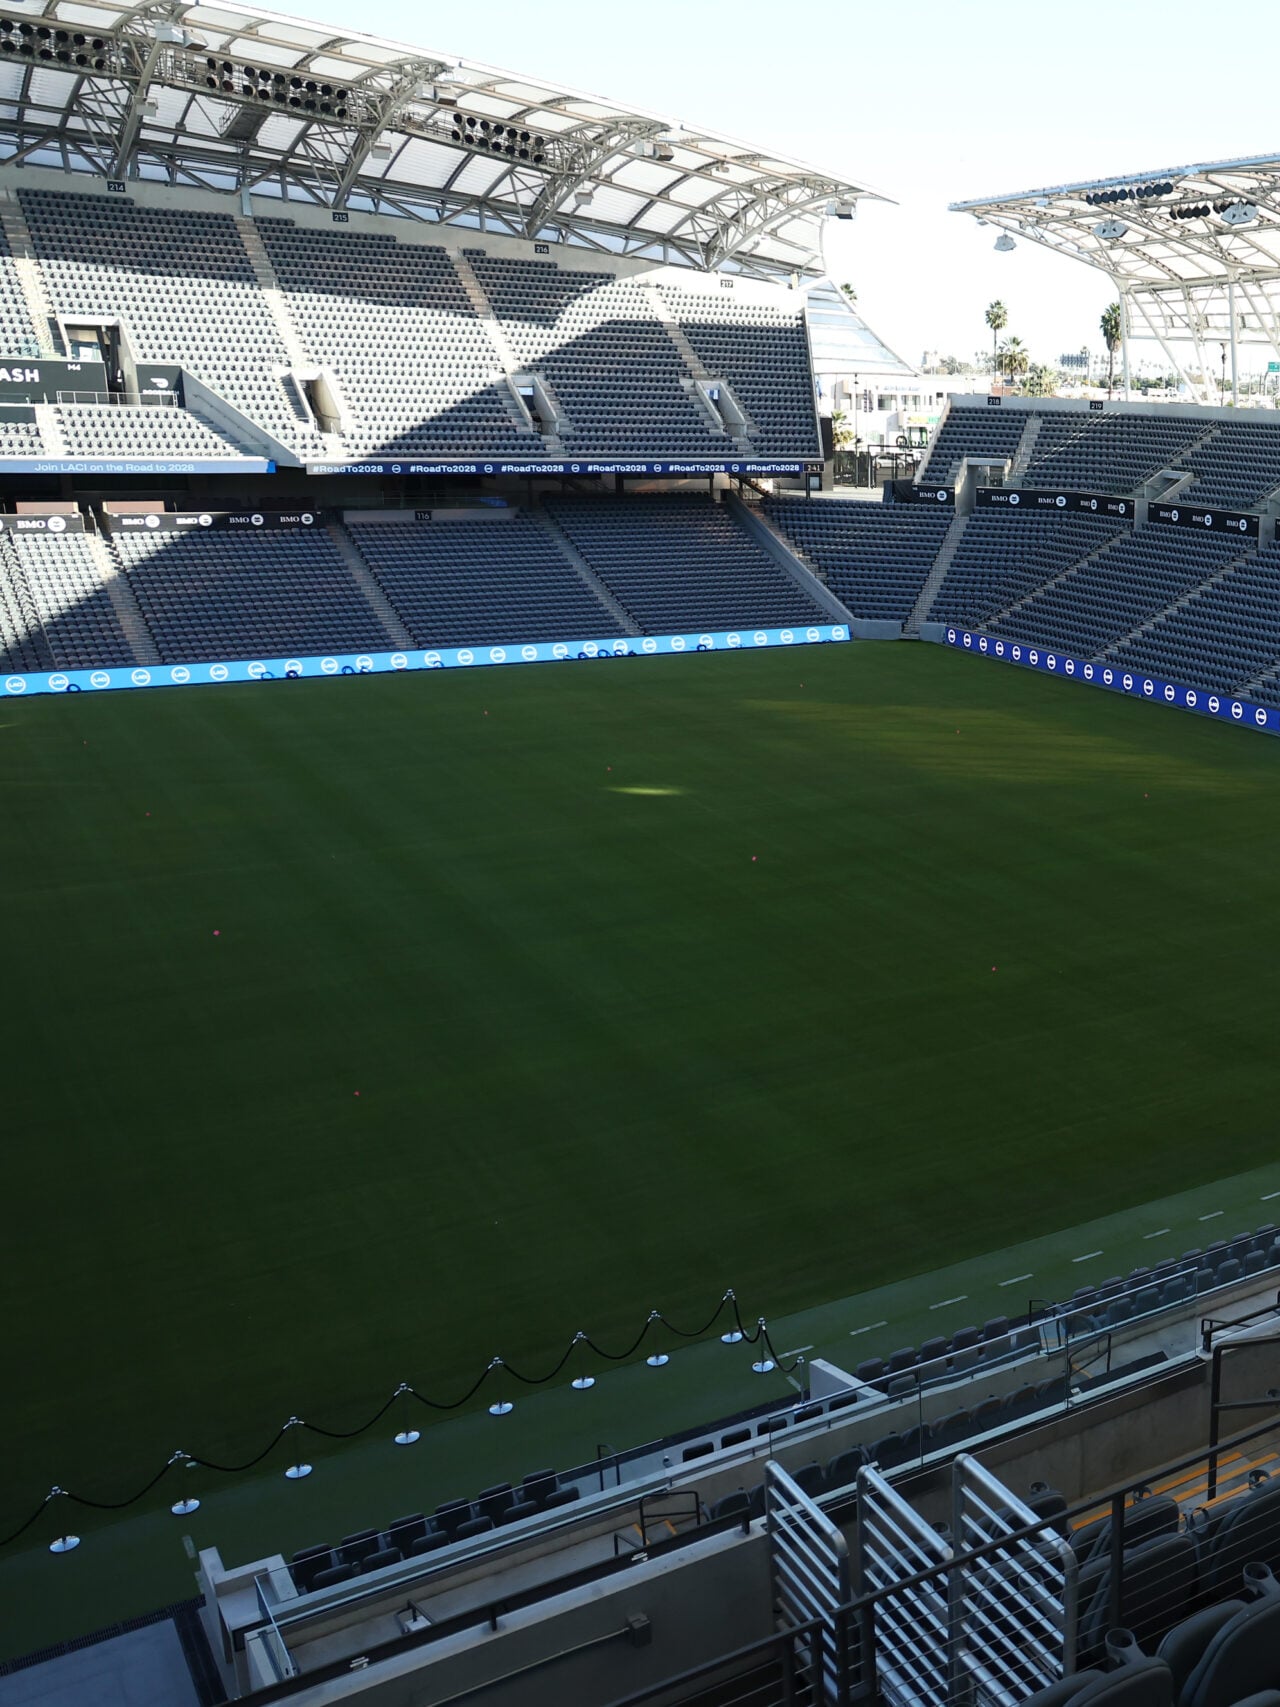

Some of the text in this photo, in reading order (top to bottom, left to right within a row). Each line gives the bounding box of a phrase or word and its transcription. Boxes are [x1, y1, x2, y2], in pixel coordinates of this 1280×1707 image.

[109, 184, 124, 192] 214
[334, 214, 348, 222] 215
[0, 368, 40, 382] ASH
[34, 463, 58, 472] Join
[61, 464, 87, 472] LACI
[106, 464, 123, 472] the
[126, 463, 151, 472] Road
[153, 464, 166, 472] to
[169, 464, 194, 472] 2028
[313, 465, 383, 473] #RoadTo2028
[410, 464, 477, 472] #RoadTo2028
[501, 464, 564, 472] #RoadTo2028
[587, 464, 647, 472] #RoadTo2028
[229, 516, 249, 524] BMO
[417, 512, 429, 520] 116
[16, 520, 46, 529] BMO
